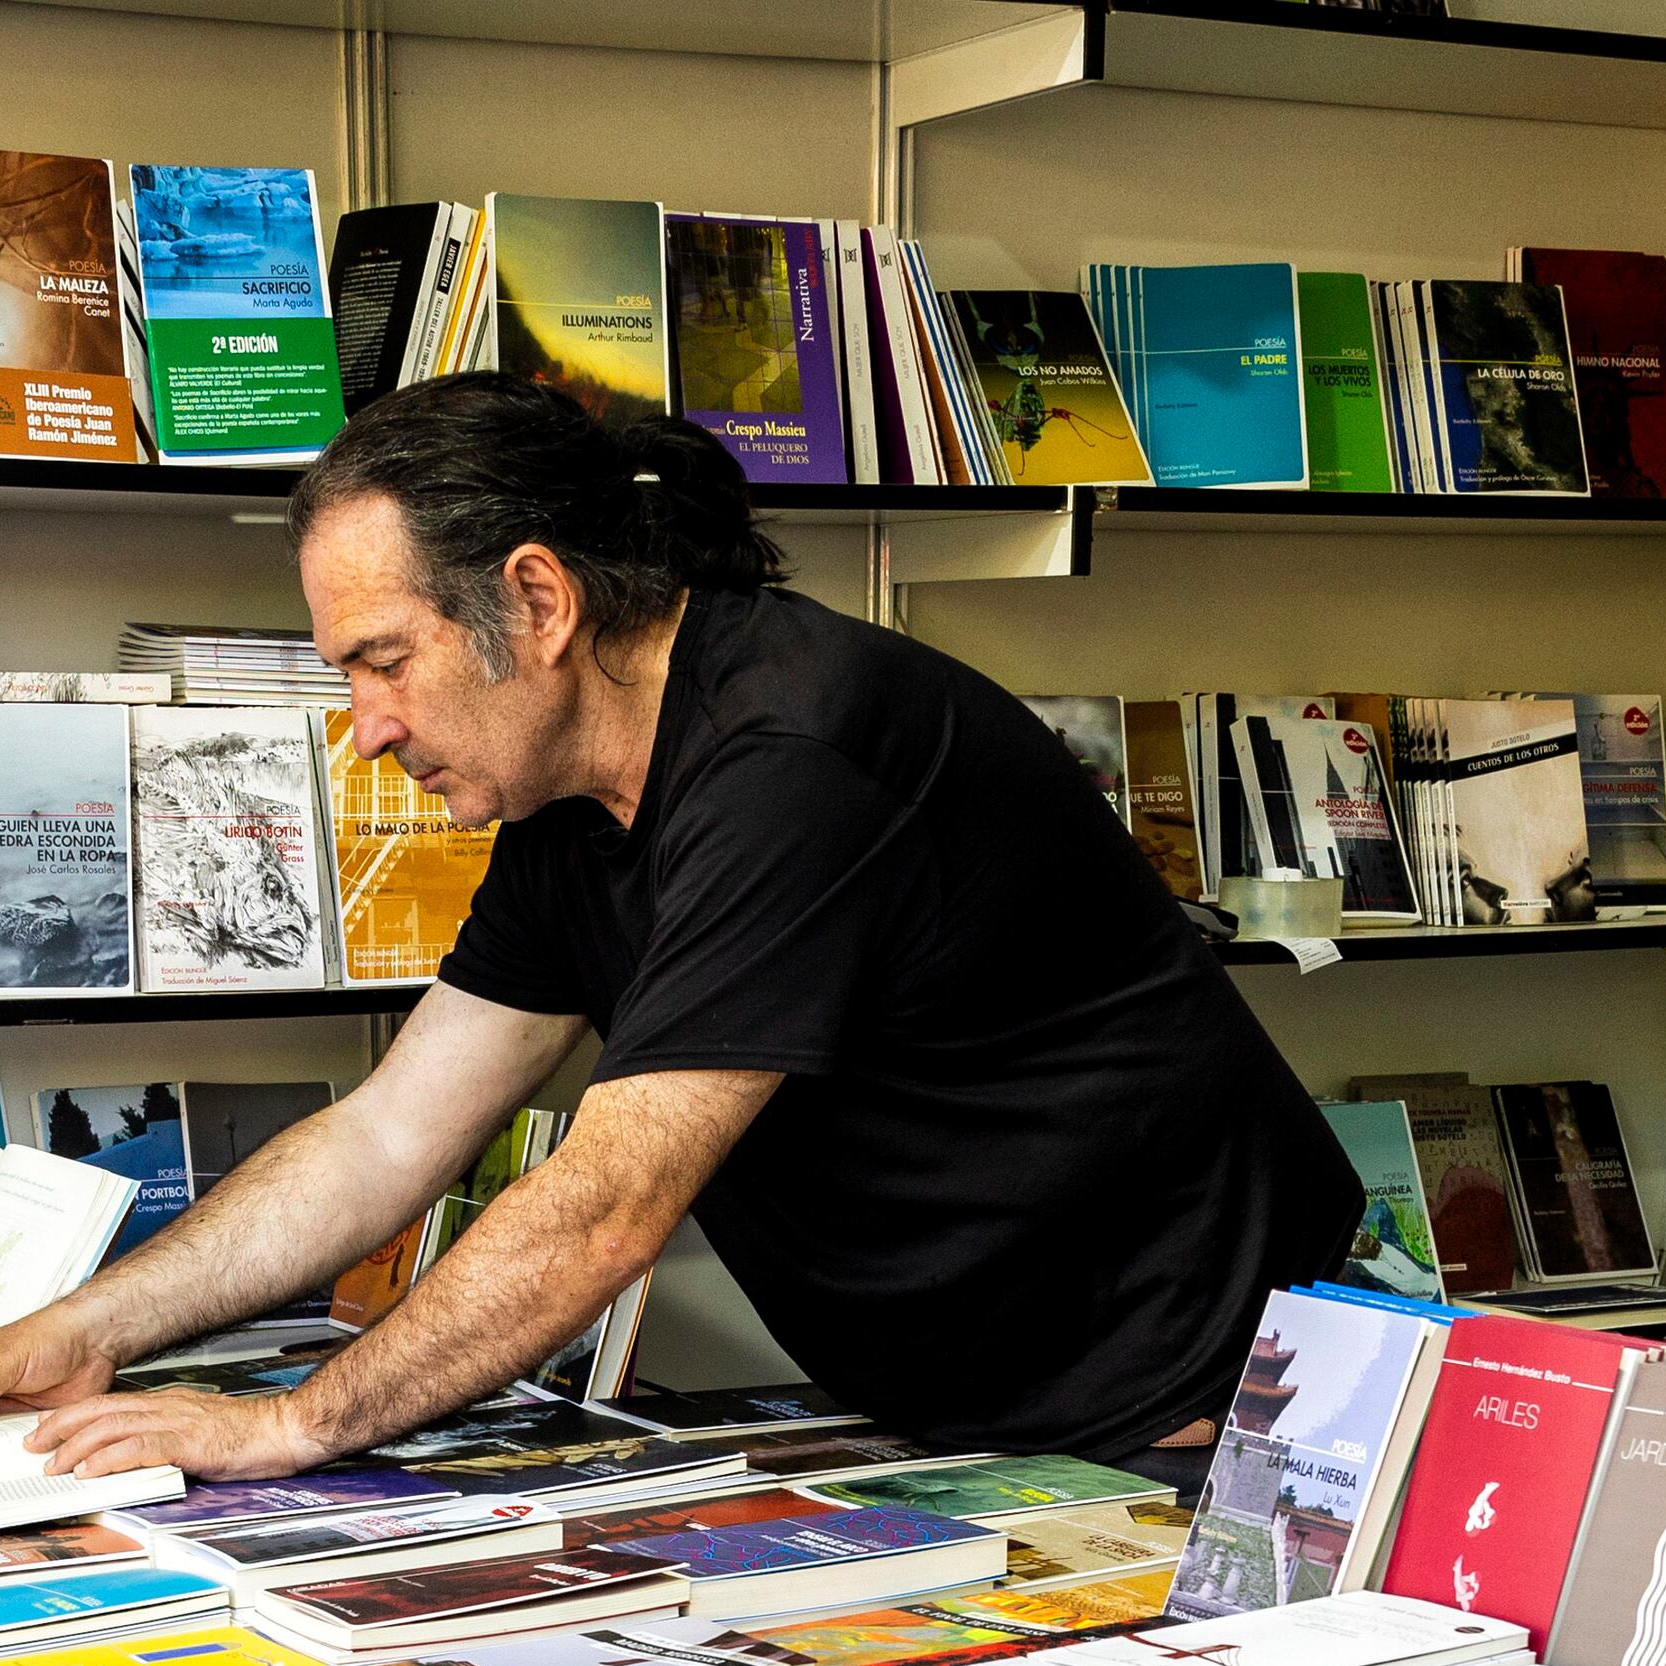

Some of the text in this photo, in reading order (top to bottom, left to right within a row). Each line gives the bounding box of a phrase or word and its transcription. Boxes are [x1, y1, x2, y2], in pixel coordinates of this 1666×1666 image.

[270, 262, 309, 275] POESÍA
[40, 275, 109, 295] LA MALEZA
[242, 282, 311, 295] SACRIFICIO
[37, 291, 109, 307] Romina Berenice
[253, 298, 313, 310] Marta Agudo
[84, 306, 110, 318] Canet
[562, 314, 652, 329] ILLUMINATIONS
[212, 333, 278, 354] 2ª EDICIÓN
[587, 332, 653, 343] Arthur Rimbaud
[1240, 354, 1287, 365] EL PADRE
[1478, 368, 1565, 381] LA CÉLULA DE ORO
[24, 383, 92, 400] XLIII Premio
[26, 398, 113, 417] Iberoamericano
[27, 415, 111, 431] de Poesía Juan
[28, 428, 117, 446] Ramón Jiménez
[1468, 743, 1559, 772] CUENTOS DE LOS OTROS
[43, 819, 81, 834] LLEVA
[85, 820, 116, 834] UNA
[38, 834, 116, 849] ESCONDIDA
[37, 849, 116, 863] EN LA ROPA
[1473, 1395, 1542, 1431] ARILES
[1266, 1451, 1358, 1491] LA MALA HIERBA
